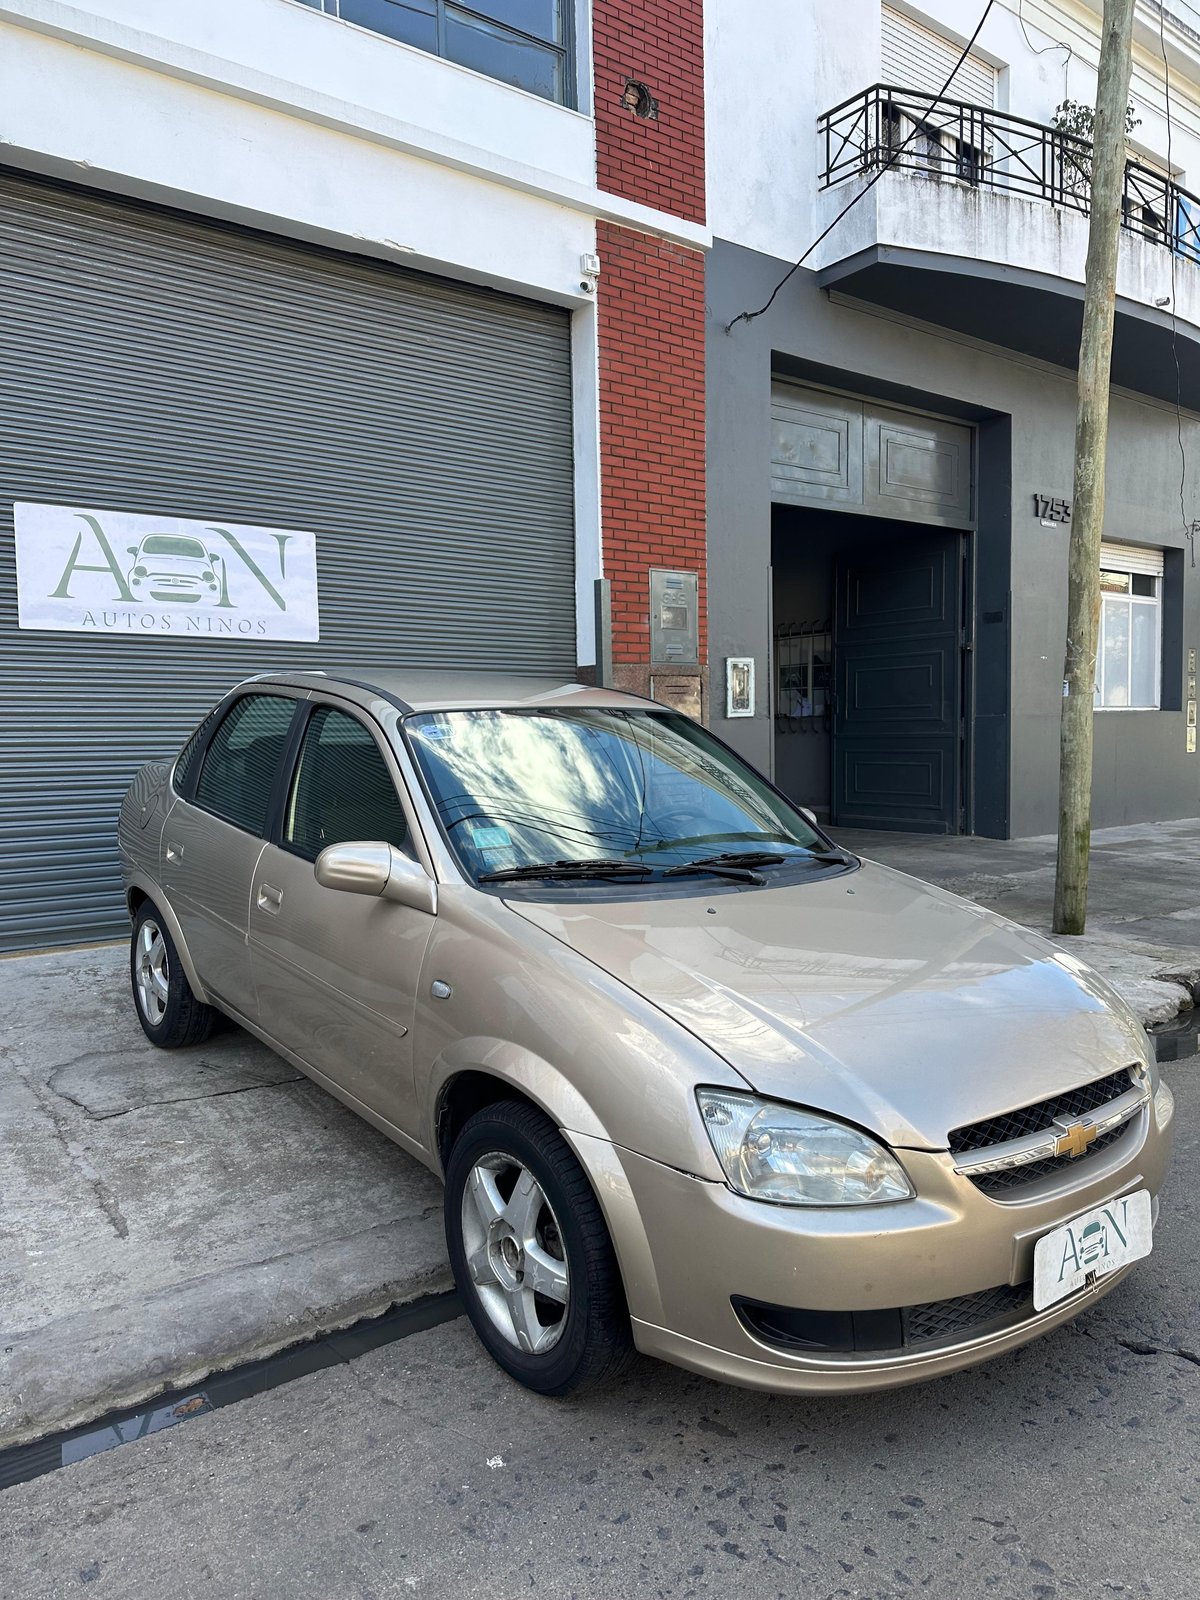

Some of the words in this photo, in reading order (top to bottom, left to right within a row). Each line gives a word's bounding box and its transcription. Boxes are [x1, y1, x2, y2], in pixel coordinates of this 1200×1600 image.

[1033, 493, 1072, 524] 1753
[81, 610, 171, 630] AUTOS
[186, 616, 267, 635] NINOS
